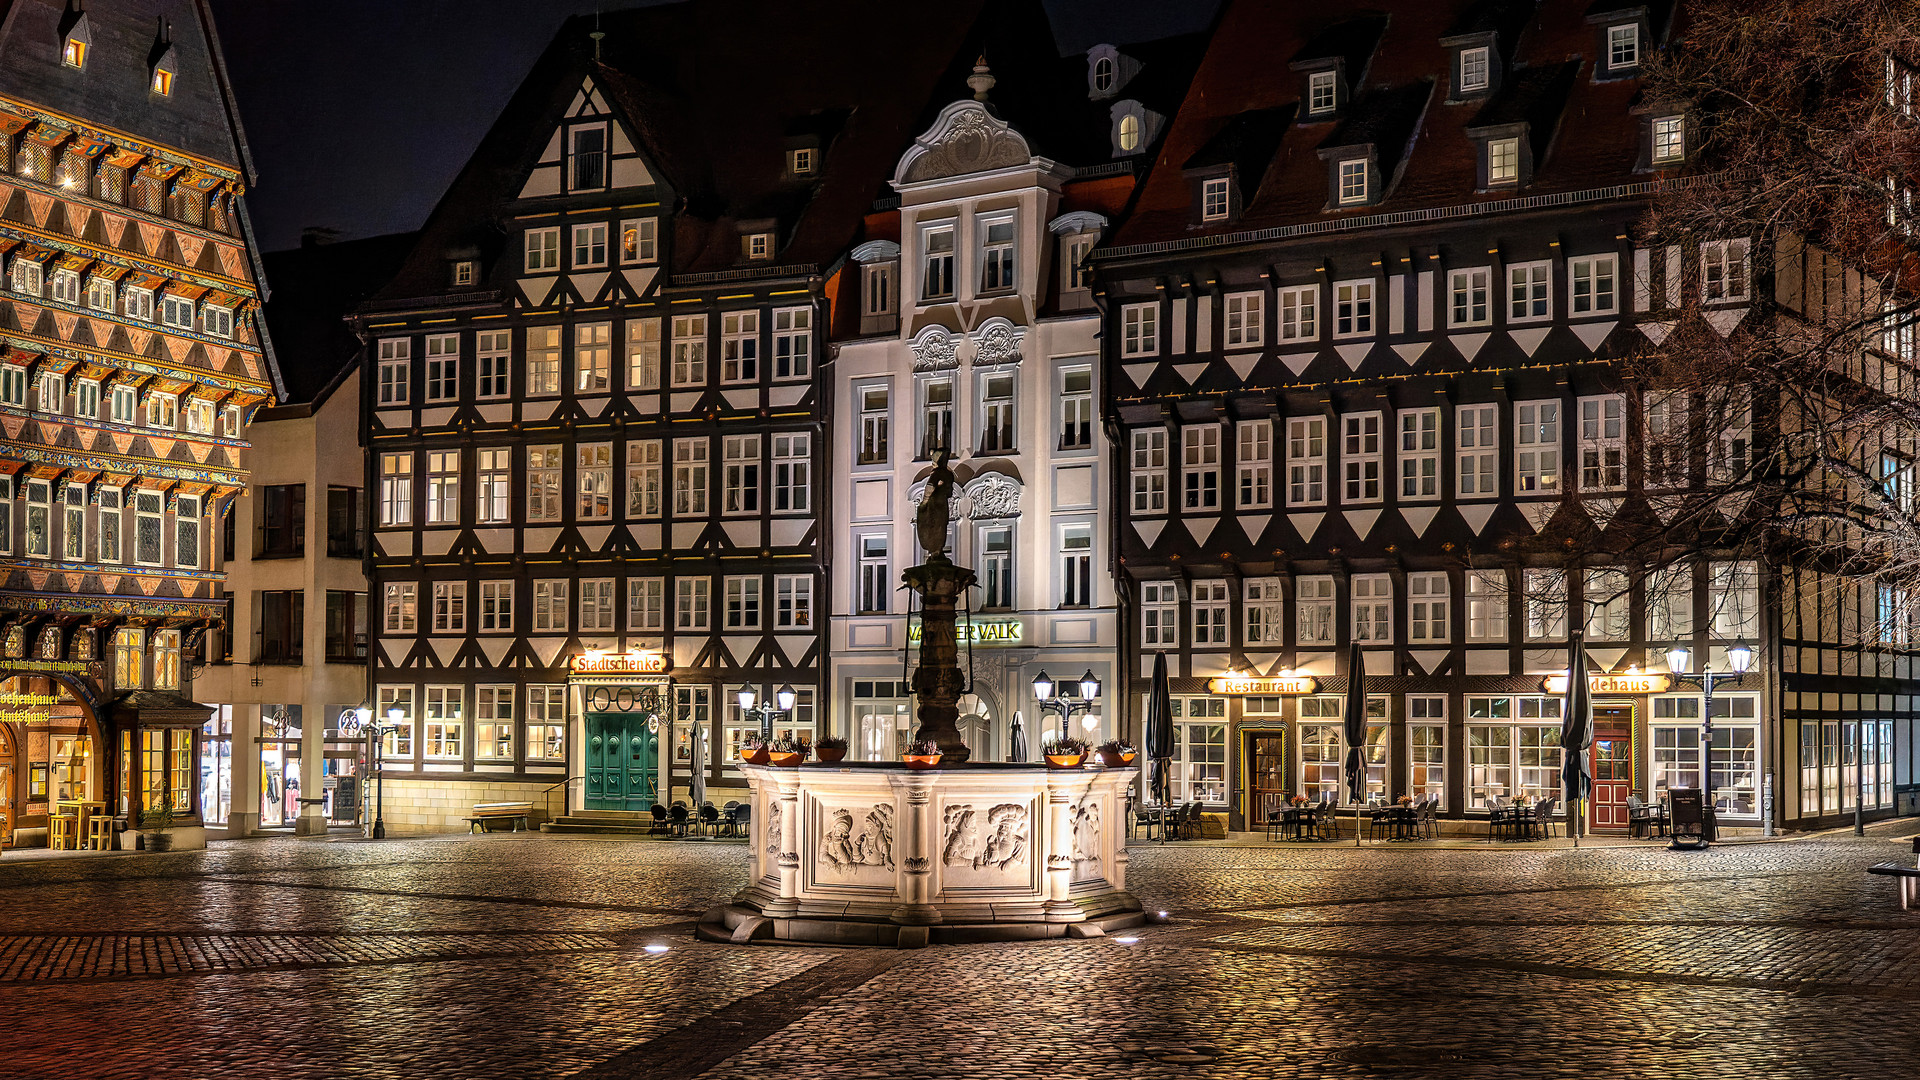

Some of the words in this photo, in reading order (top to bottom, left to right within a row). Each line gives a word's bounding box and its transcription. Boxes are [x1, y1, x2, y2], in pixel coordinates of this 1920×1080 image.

[956, 626, 977, 640] ER
[977, 623, 1019, 639] VALK
[578, 656, 660, 671] Stadtschenke
[1225, 681, 1301, 692] Restaurant
[1590, 678, 1650, 691] dehaus
[0, 691, 59, 708] ochenhauer
[274, 716, 288, 730] 23
[342, 716, 359, 730] 23
